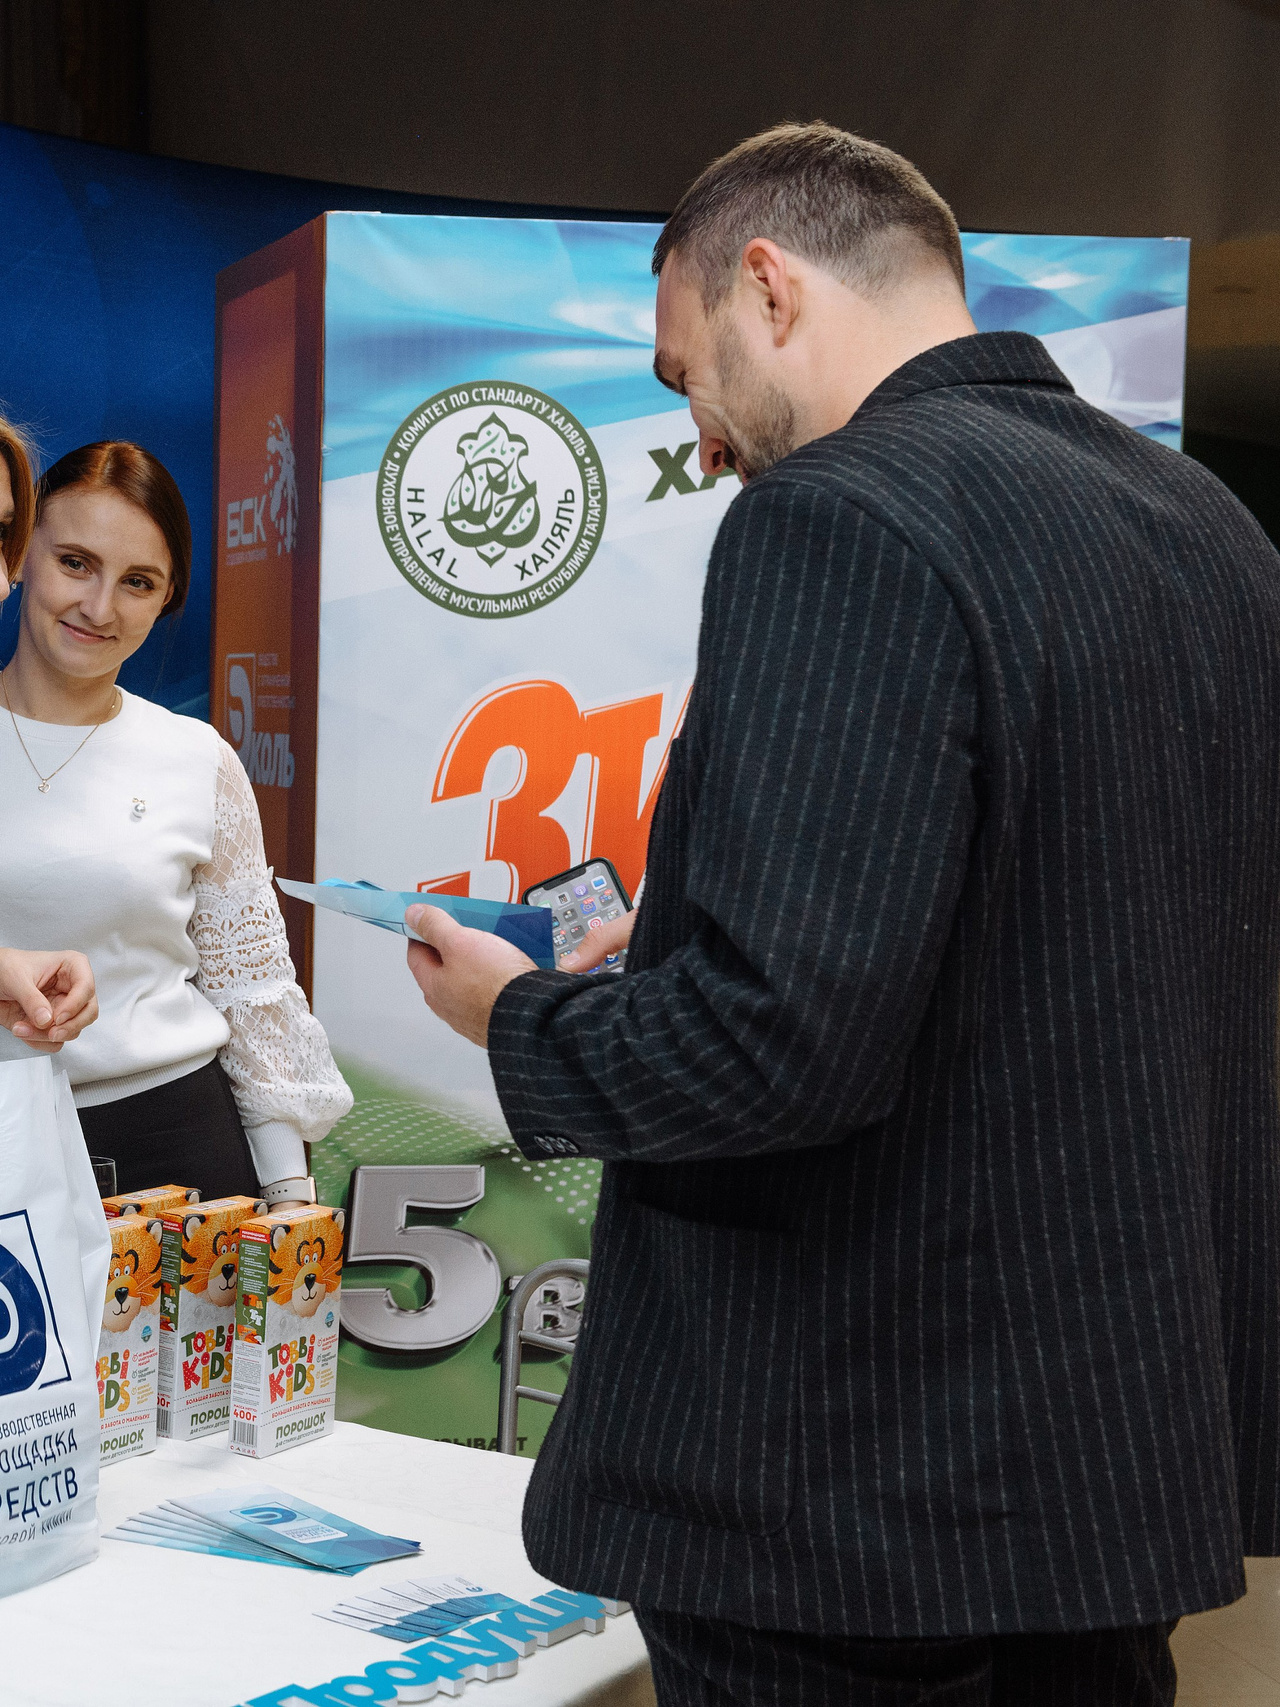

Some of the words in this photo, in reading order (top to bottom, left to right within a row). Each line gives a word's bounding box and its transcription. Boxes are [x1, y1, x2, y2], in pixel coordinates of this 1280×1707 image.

[397, 399, 448, 451] КОМИТЕТ
[450, 389, 471, 408] ПО
[471, 387, 550, 415] СТАНДАРТУ
[546, 406, 588, 458] ХАЛЯЛЬ
[382, 459, 400, 533] ДУХОВНОЕ
[582, 465, 598, 540] ТАТАРСТАН
[390, 532, 450, 602] УПРАВЛЕНИЕ
[407, 487, 459, 579] HALAL
[513, 487, 576, 582] ХАЛЯЛЬ
[449, 593, 529, 614] МУСУЛЬМАН
[529, 540, 593, 608] РЕСПУБЛИКИ
[276, 1411, 326, 1440] ПОРОШОК
